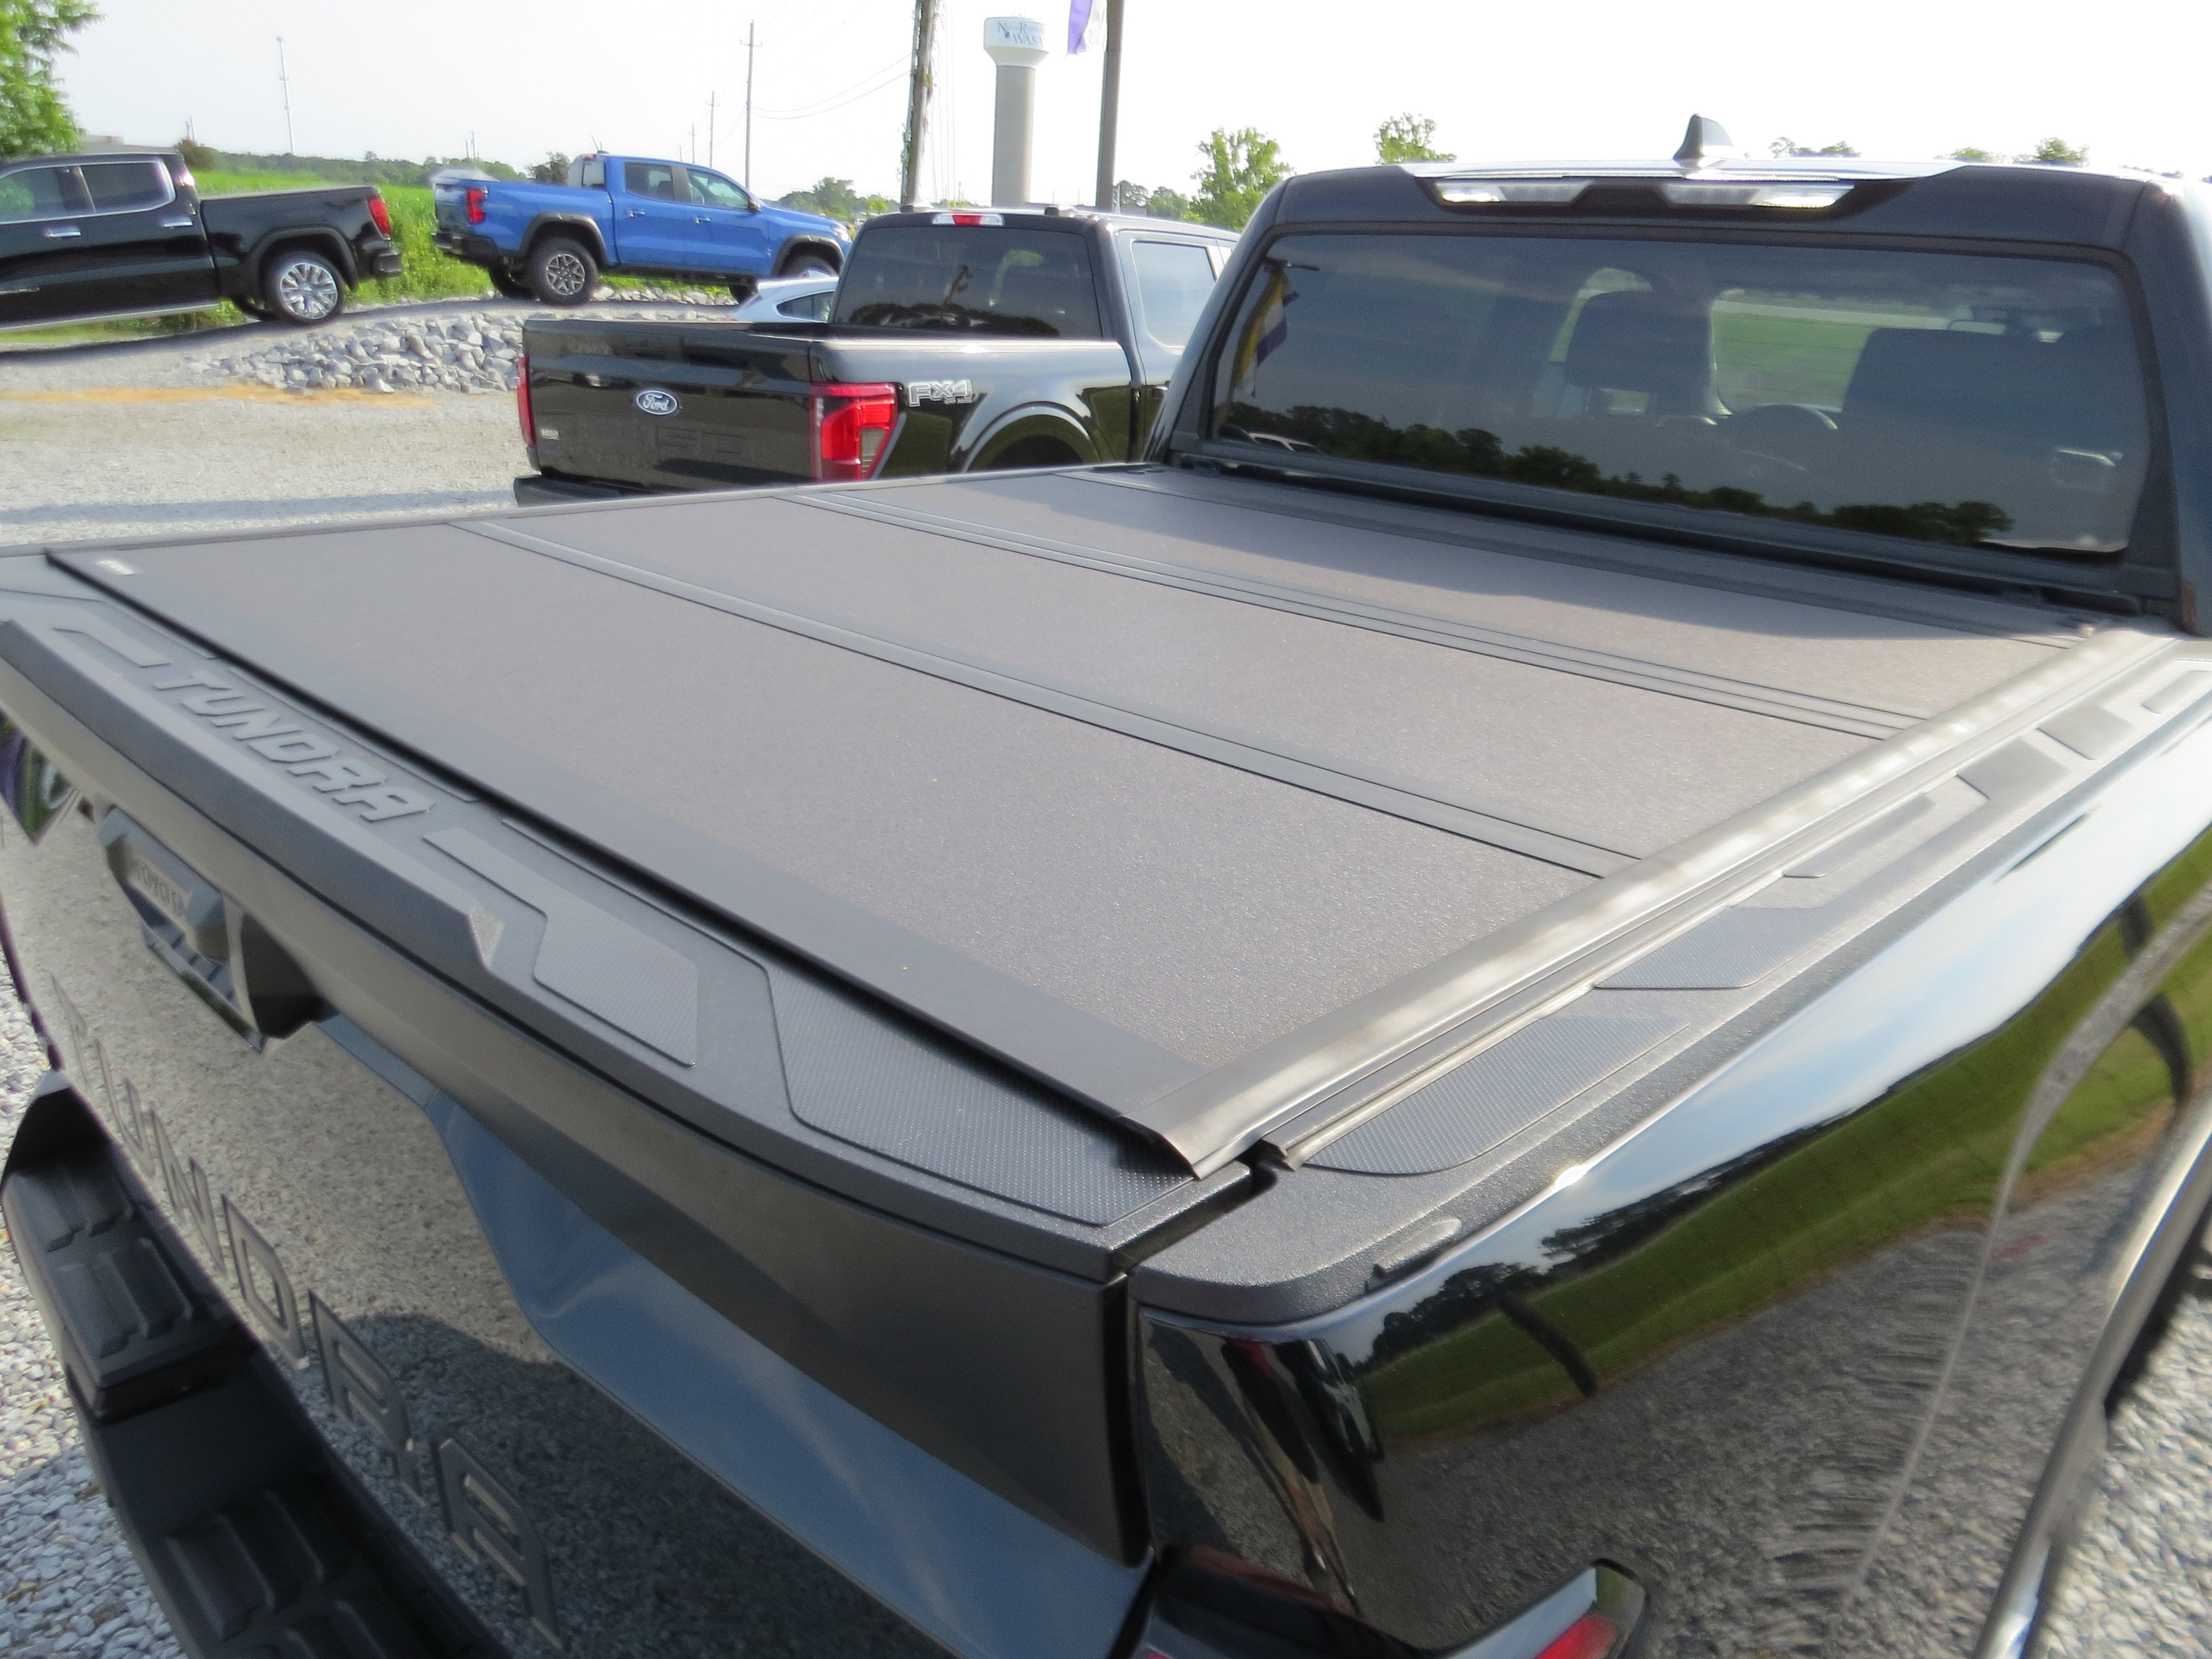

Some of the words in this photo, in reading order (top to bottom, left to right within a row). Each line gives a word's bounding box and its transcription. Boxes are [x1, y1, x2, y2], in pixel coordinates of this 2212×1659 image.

[644, 393, 669, 411] Ford
[909, 380, 973, 407] FX4
[153, 670, 436, 822] TUNDRA
[50, 972, 562, 1650] TUNDRA
